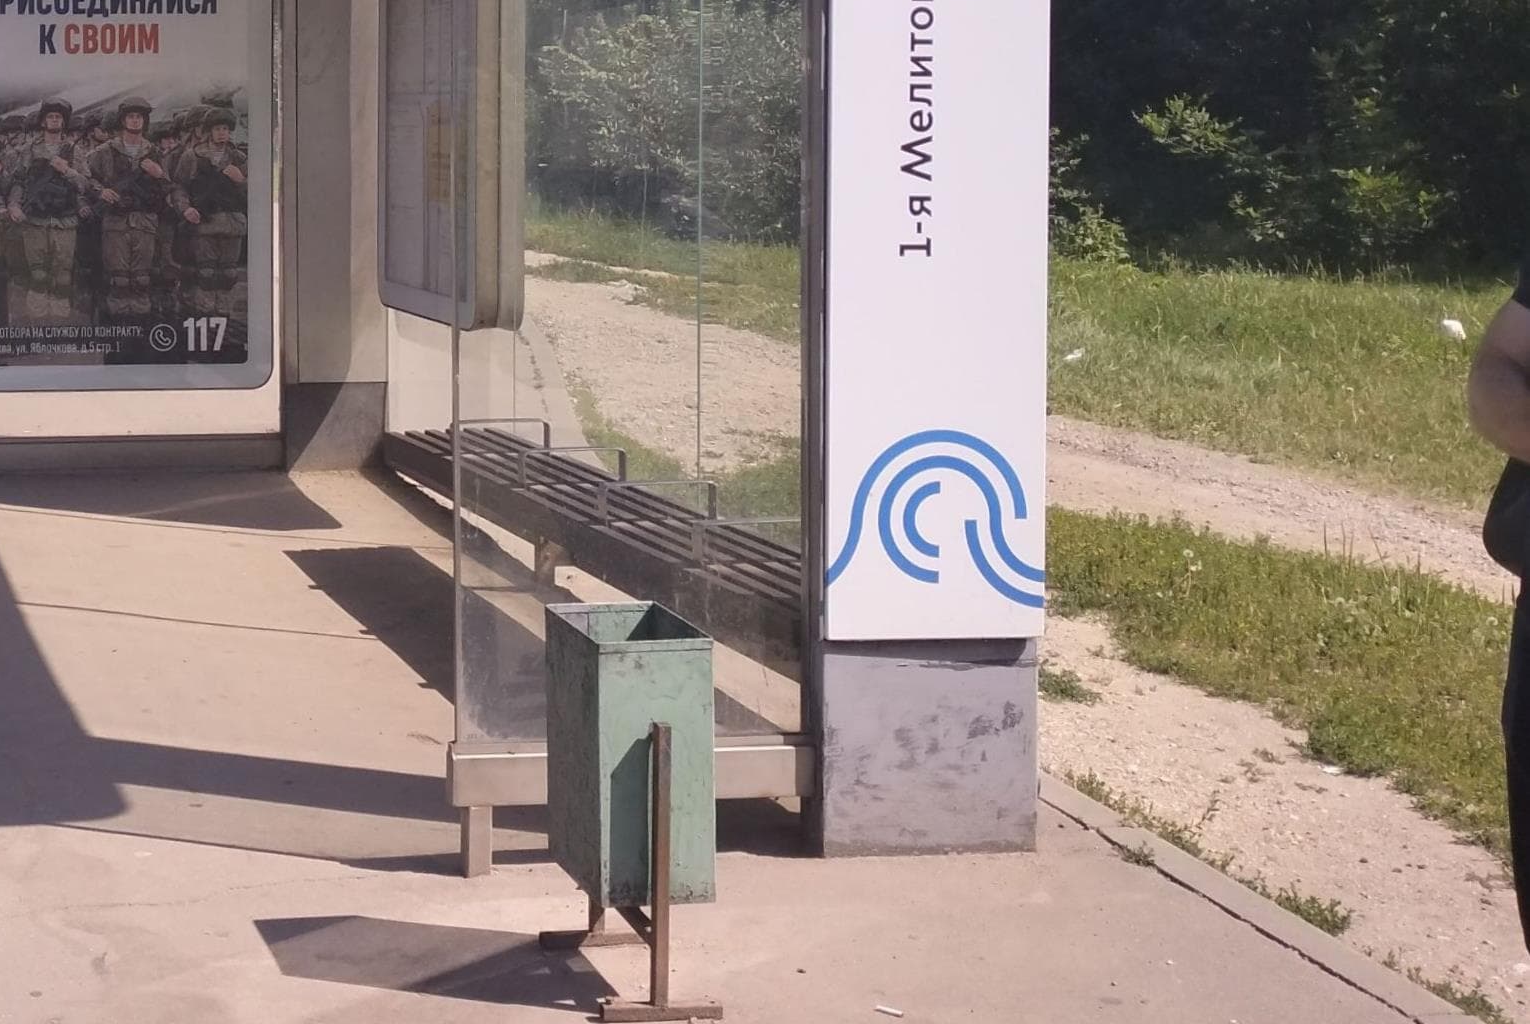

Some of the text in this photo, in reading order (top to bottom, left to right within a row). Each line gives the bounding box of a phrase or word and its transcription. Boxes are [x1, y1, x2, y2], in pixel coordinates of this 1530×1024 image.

[39, 23, 160, 55] К СВОИМ
[899, 195, 932, 258] 1-я
[0, 327, 31, 339] ОТБОРА
[32, 327, 44, 338] НА
[45, 326, 80, 338] СЛУЖБУ
[81, 327, 93, 338] ПО
[183, 317, 228, 351] 117
